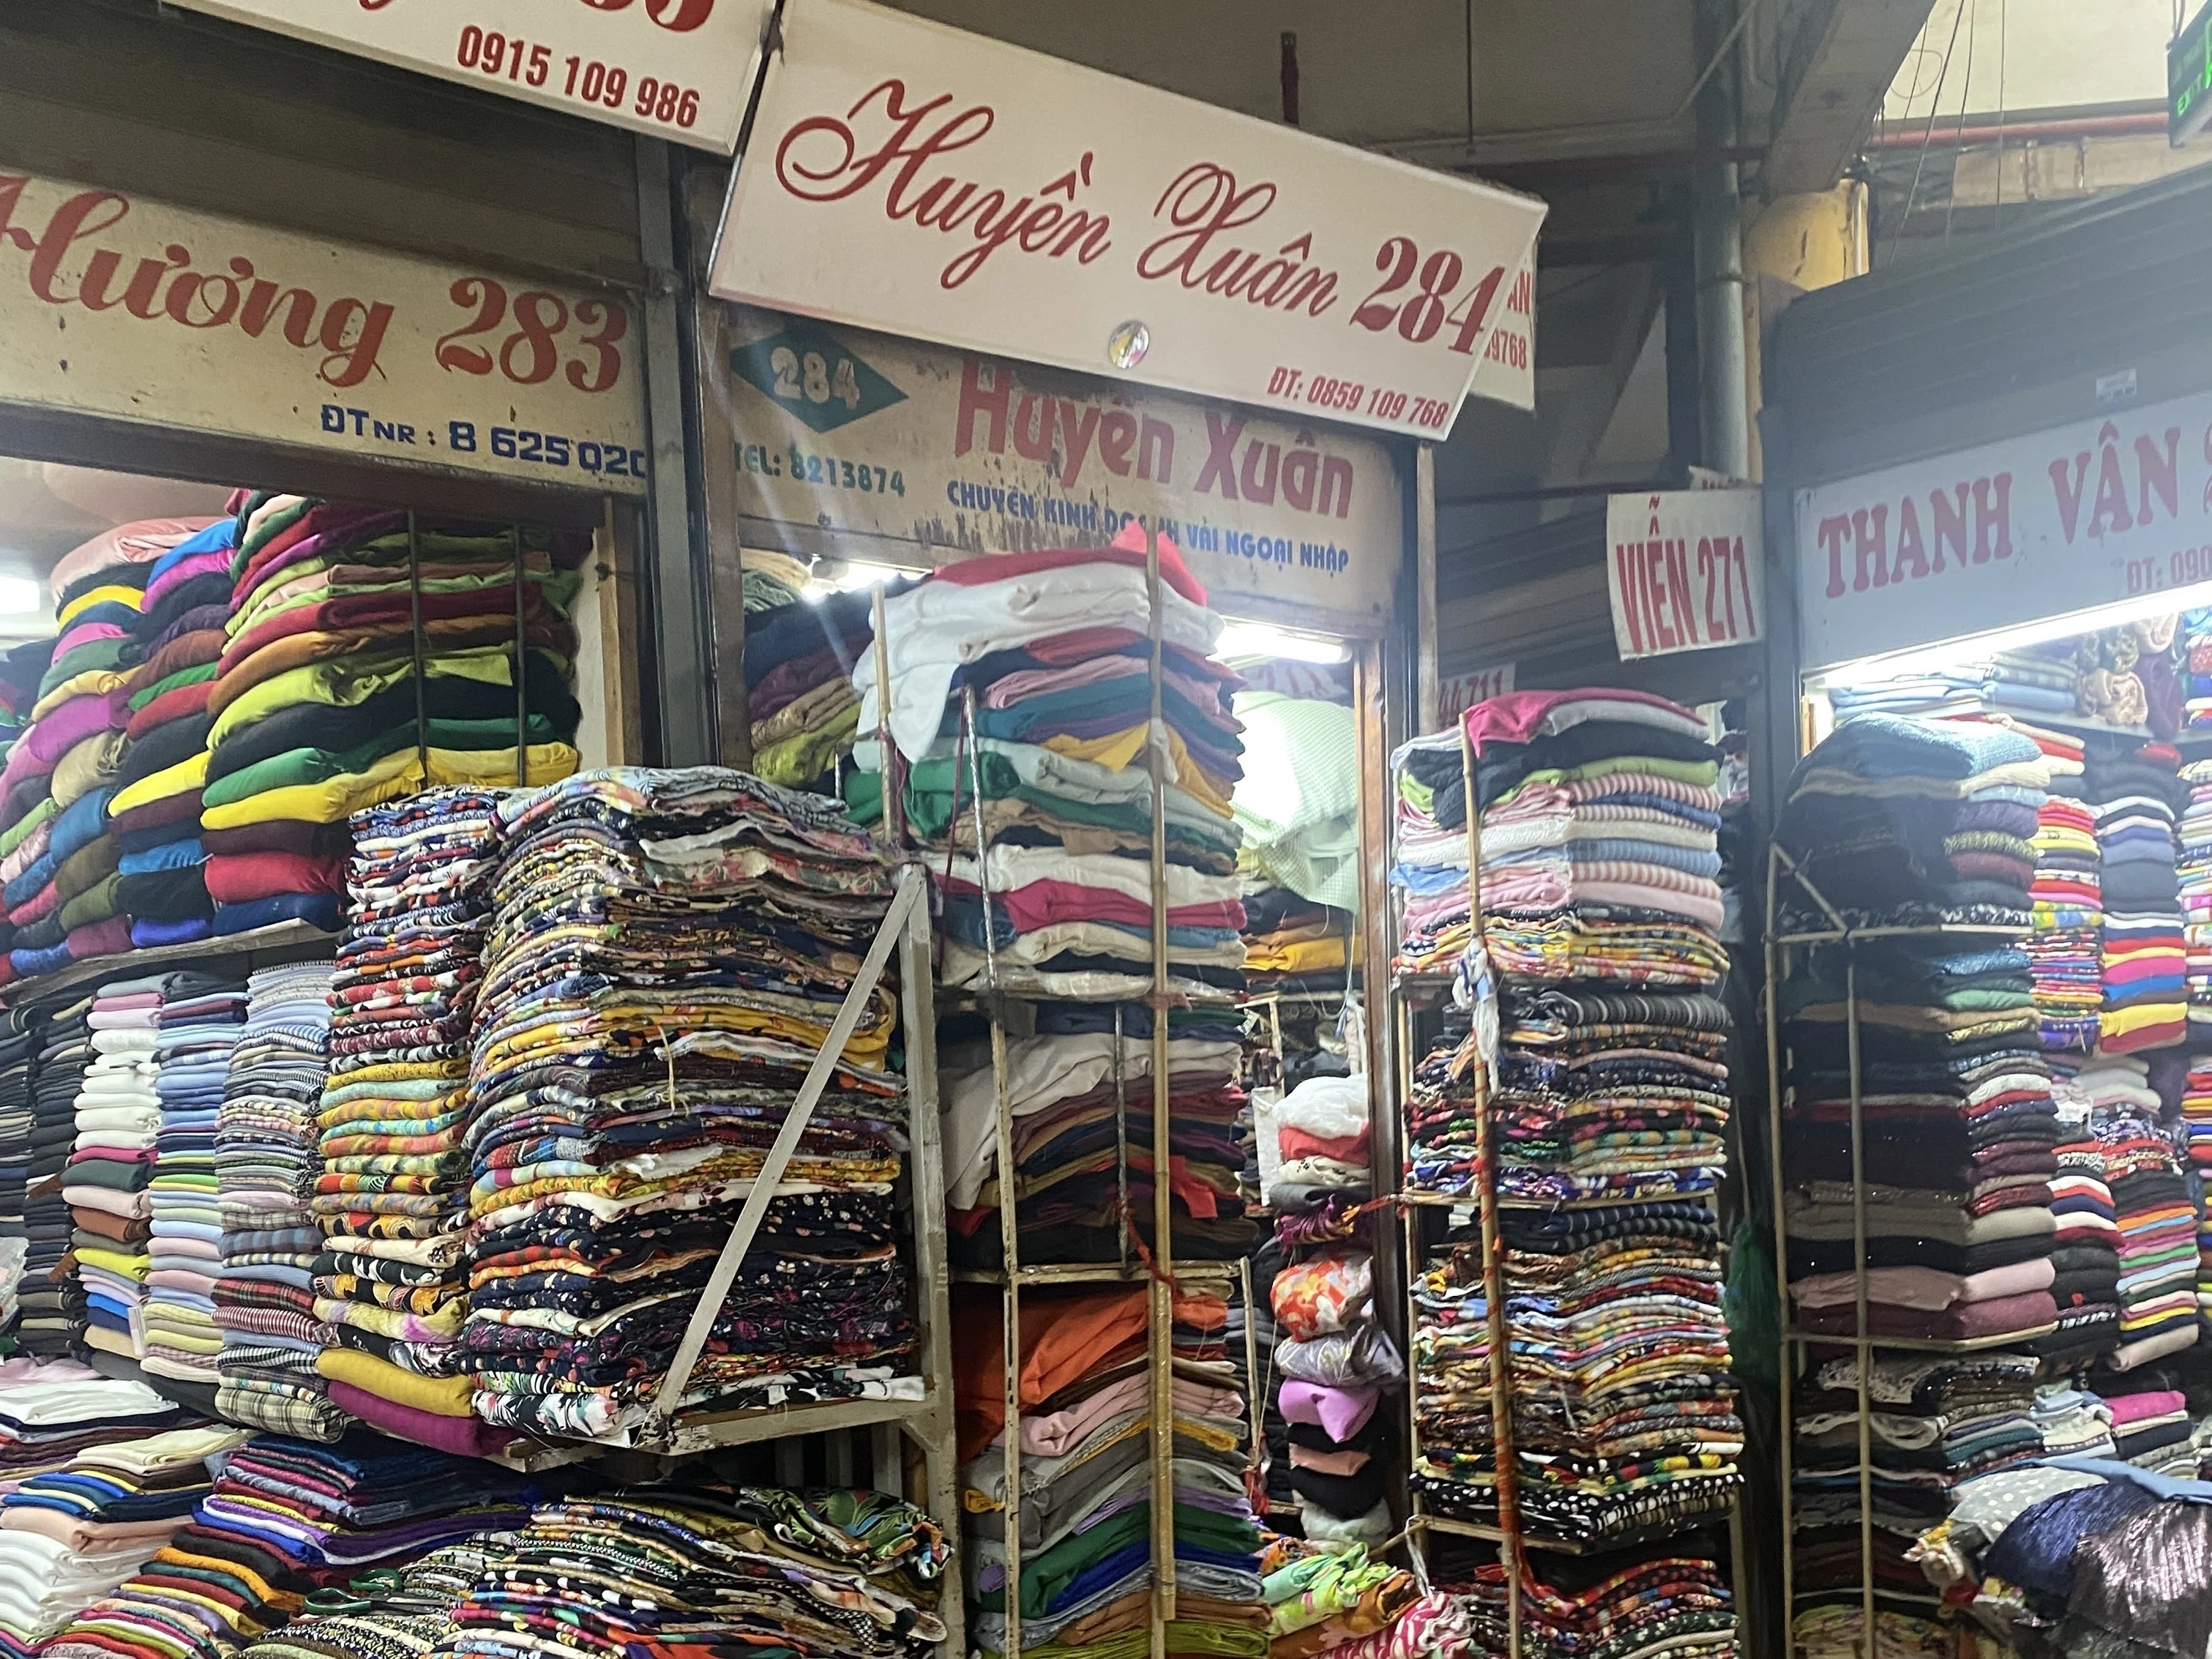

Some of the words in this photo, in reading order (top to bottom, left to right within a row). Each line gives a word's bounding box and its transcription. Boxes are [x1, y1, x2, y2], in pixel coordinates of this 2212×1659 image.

[457, 24, 551, 87] 0915
[564, 56, 627, 108] 109
[634, 76, 700, 127] 986
[775, 79, 1111, 289] Huyền
[1137, 162, 1339, 317] Xuân
[1349, 236, 1505, 356] 284
[435, 277, 628, 393] 283
[771, 346, 860, 410] 284
[448, 420, 476, 452] 8
[490, 425, 570, 467] 625
[1267, 366, 1303, 400] ĐT:
[1307, 375, 1364, 411] 0859
[1366, 387, 1408, 420] 109
[1407, 396, 1450, 428] 768
[733, 441, 781, 477] TEL:
[789, 445, 906, 498] 8213874
[1194, 410, 1354, 520] Xuân
[1817, 471, 2014, 600] THANH
[2048, 420, 2182, 545] VÂN
[946, 479, 1035, 520] CHUYÊN
[1225, 528, 1293, 573] NGOẠI
[1615, 493, 1700, 654] VIỄN
[1697, 535, 1757, 642] 271
